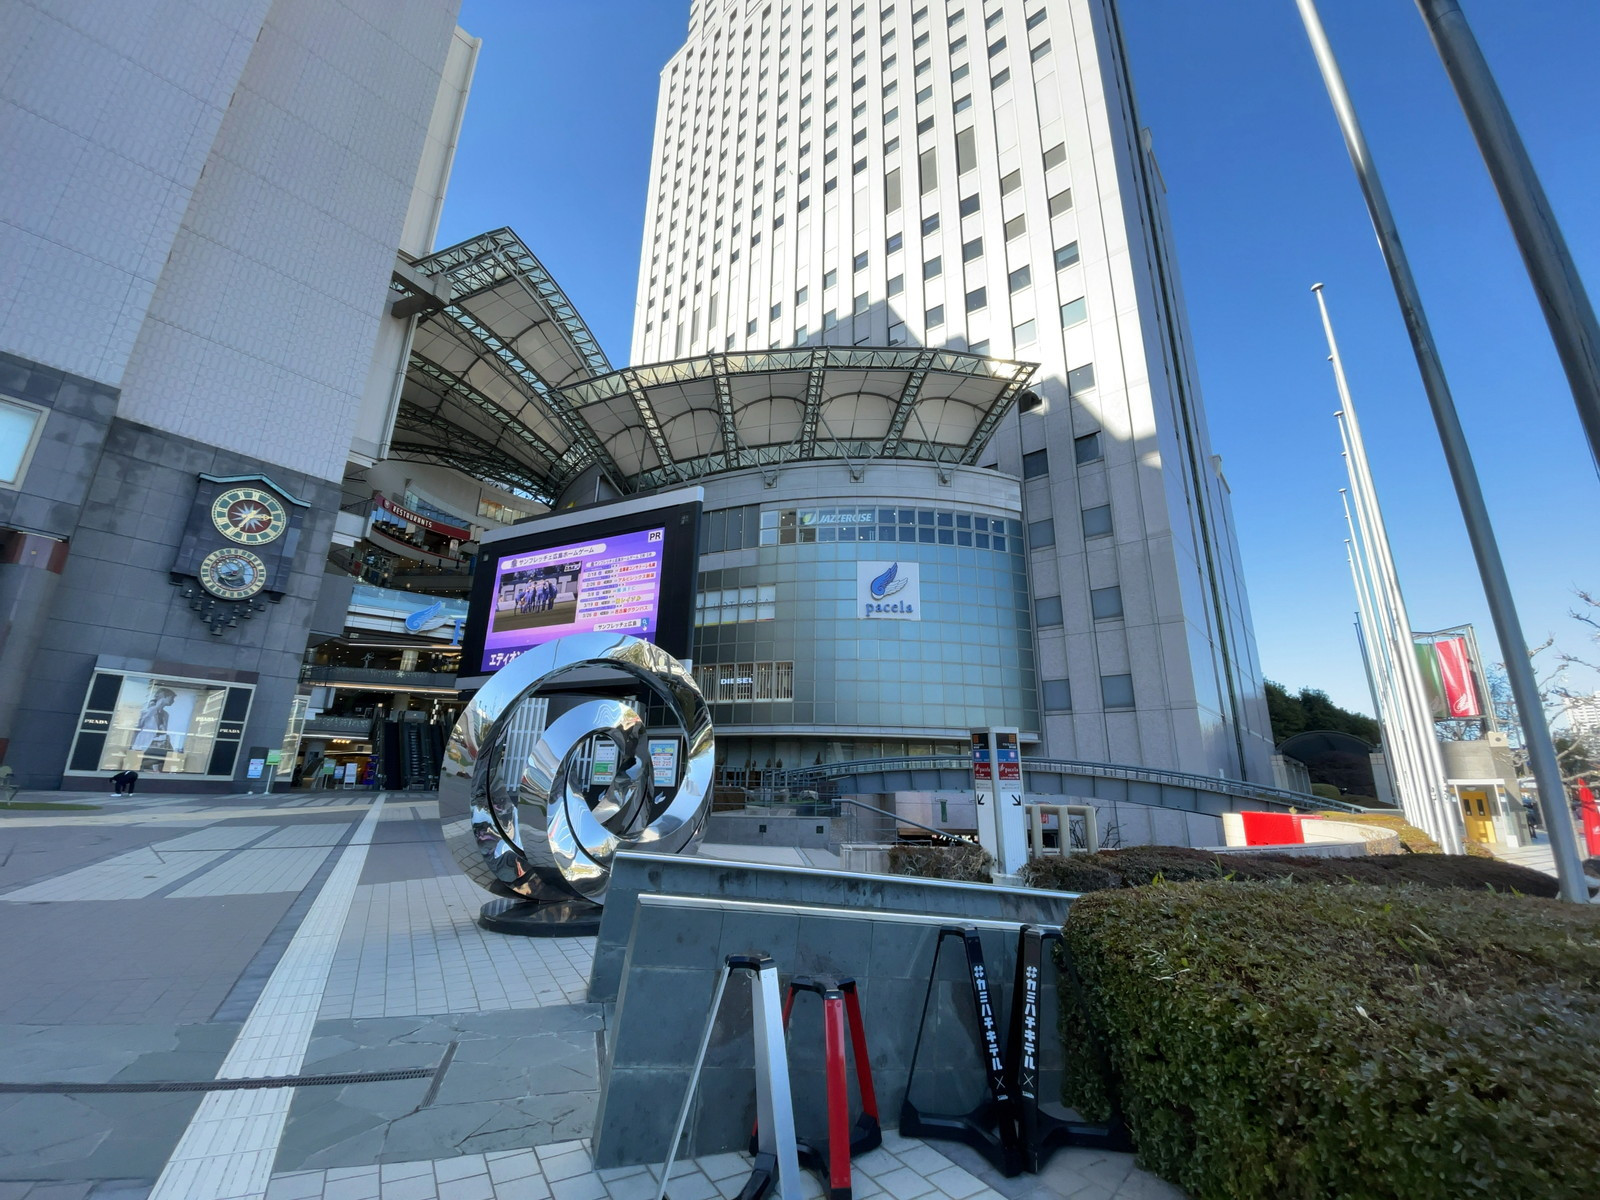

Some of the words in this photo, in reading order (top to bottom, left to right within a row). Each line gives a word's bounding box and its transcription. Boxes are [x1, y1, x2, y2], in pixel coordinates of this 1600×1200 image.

[392, 505, 432, 528] RESTAURANTS
[650, 531, 661, 540] PR
[865, 600, 913, 617] pacela
[720, 677, 754, 685] DIESEL
